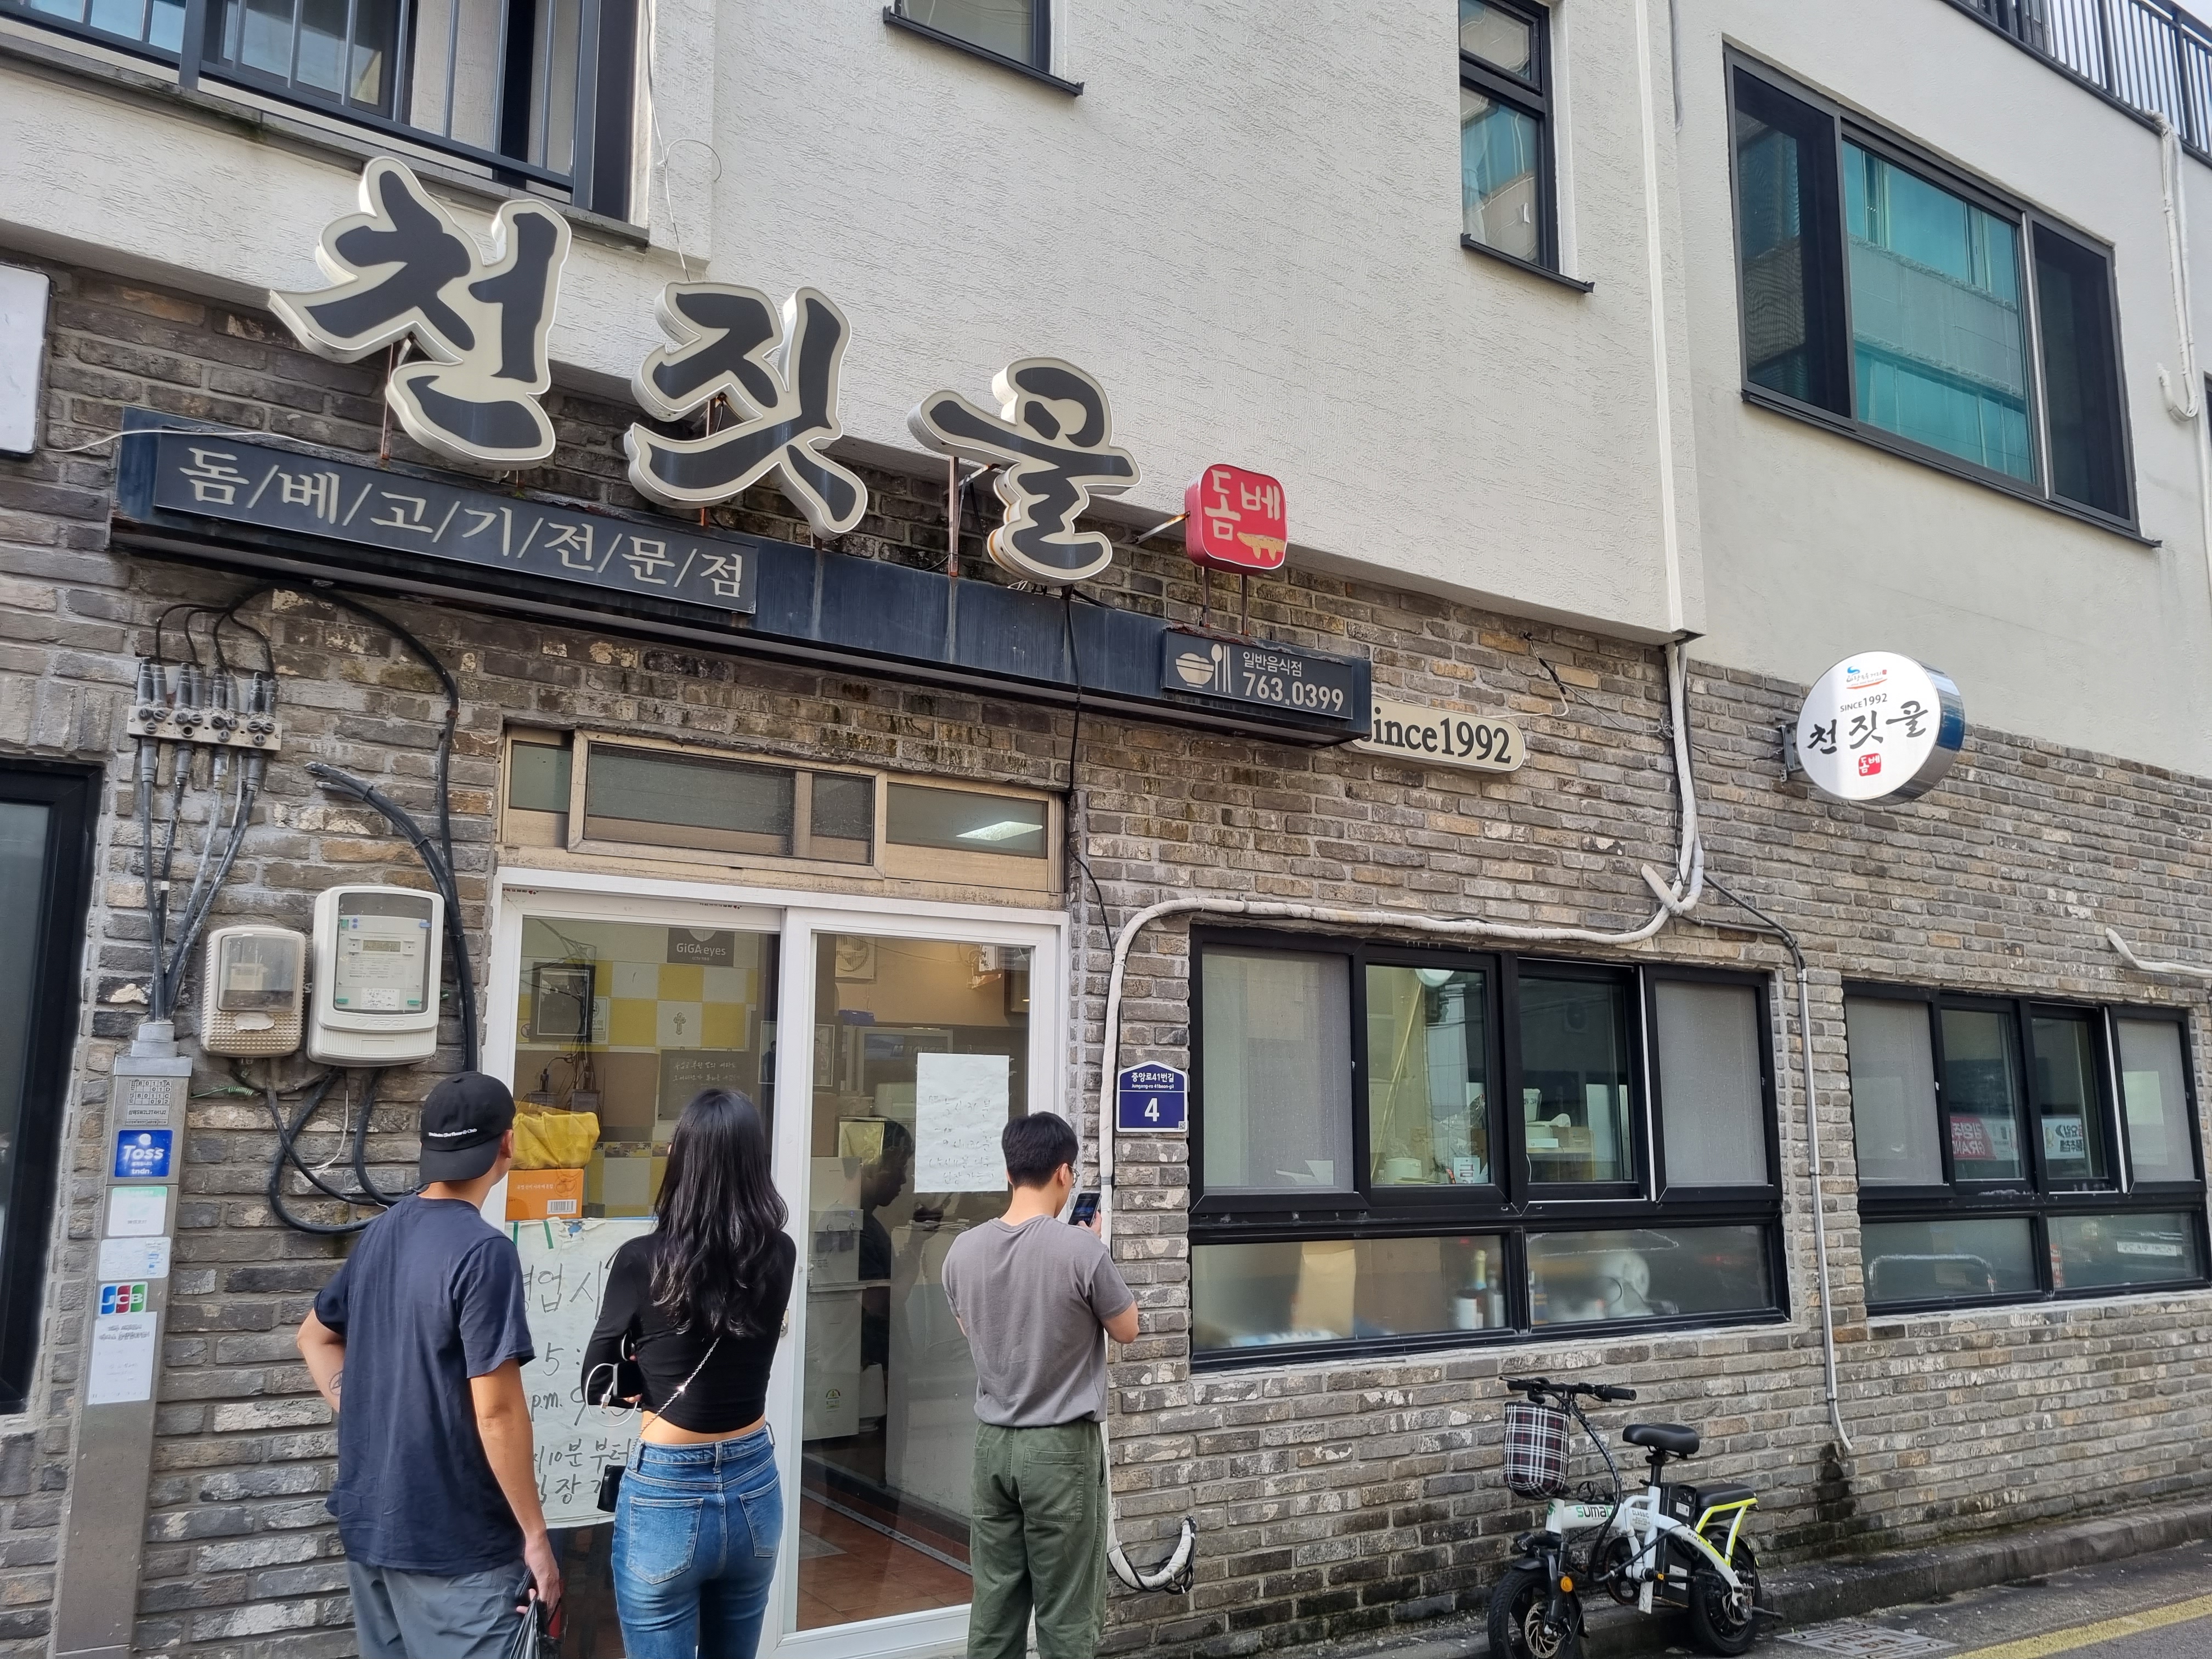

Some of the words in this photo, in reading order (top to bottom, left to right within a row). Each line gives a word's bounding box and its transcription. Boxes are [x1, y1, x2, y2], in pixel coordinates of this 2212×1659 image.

[1203, 470, 1282, 541] 돔베
[1243, 651, 1302, 678] 일반음식점
[1363, 706, 1512, 764] ince1992
[1859, 754, 1881, 774] 돔베
[1131, 1072, 1174, 1083] 중앙로41번길
[1144, 1098, 1160, 1122] 4
[123, 1145, 165, 1159] Toss
[101, 1293, 144, 1306] JCB
[589, 1437, 632, 1475] 부터
